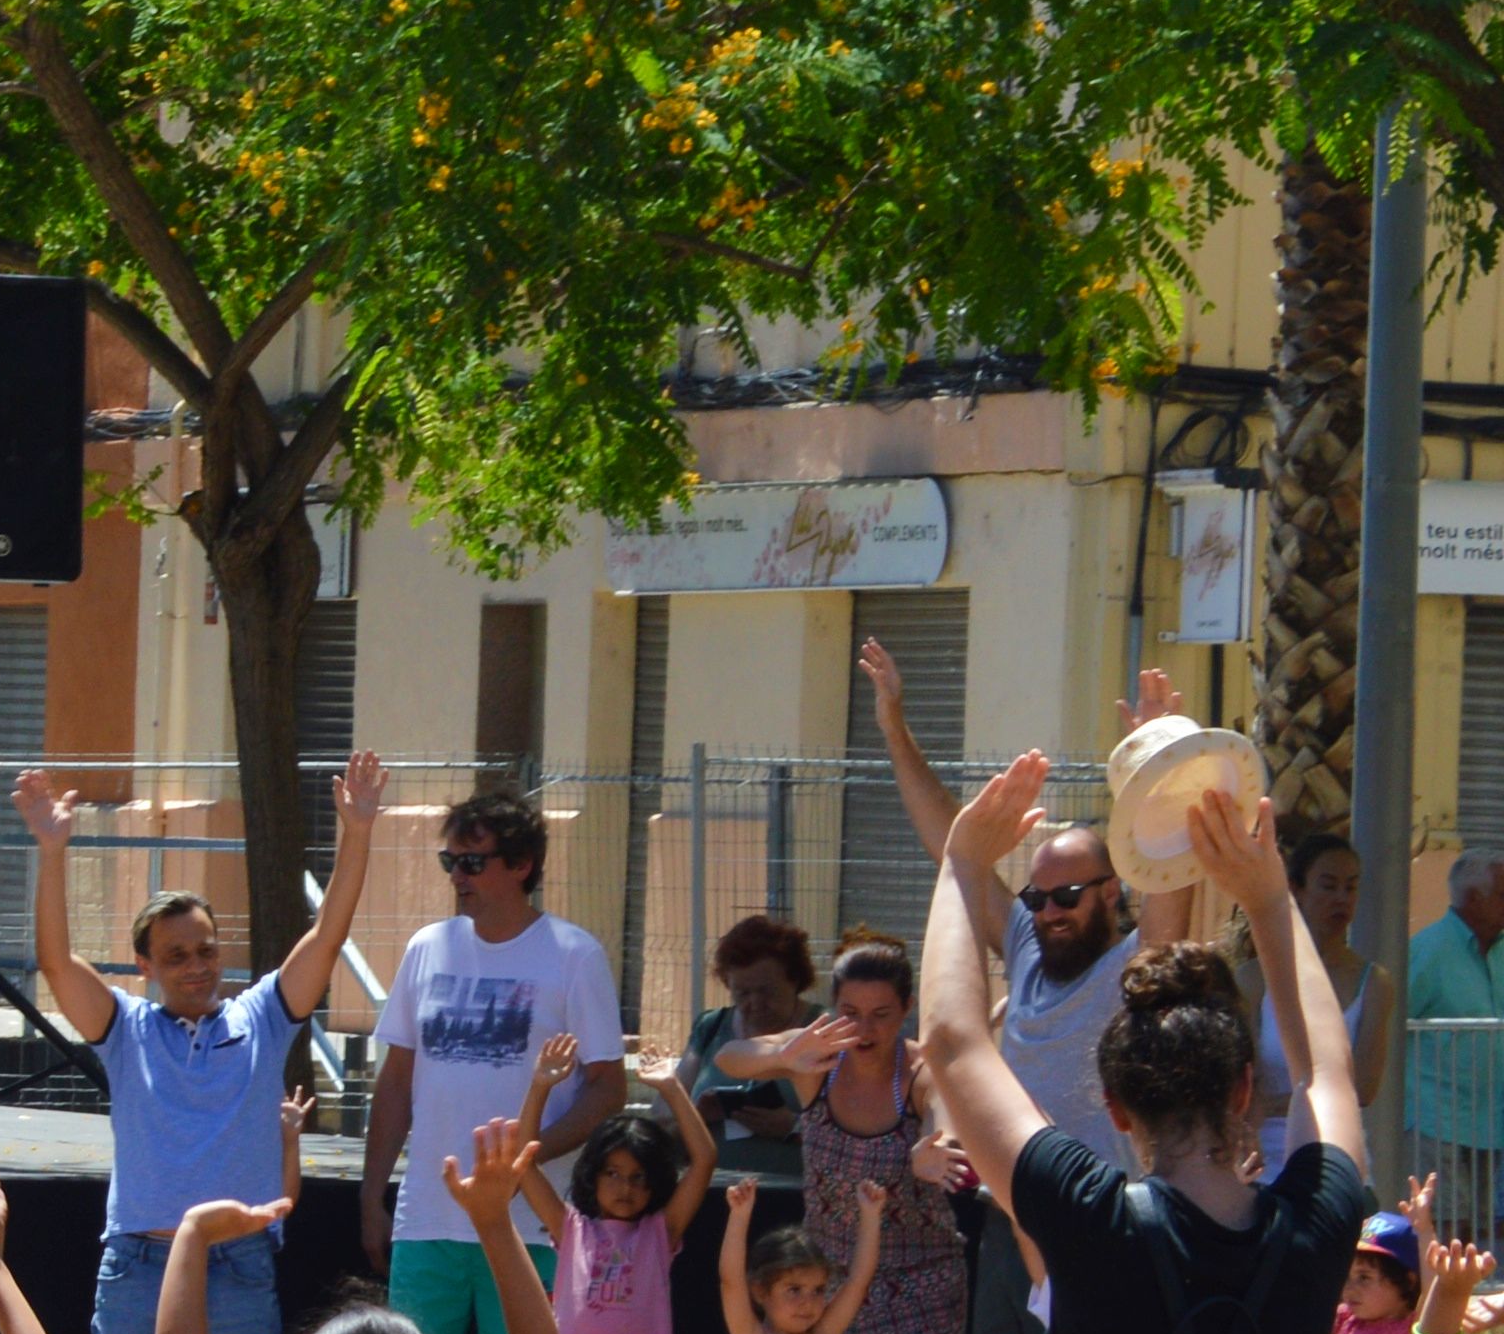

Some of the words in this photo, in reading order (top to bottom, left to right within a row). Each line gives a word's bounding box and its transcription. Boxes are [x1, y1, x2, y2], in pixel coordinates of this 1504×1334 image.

[873, 524, 937, 543] COMPLEMENTS
[1426, 524, 1458, 540] teu
[1464, 543, 1504, 560] més
